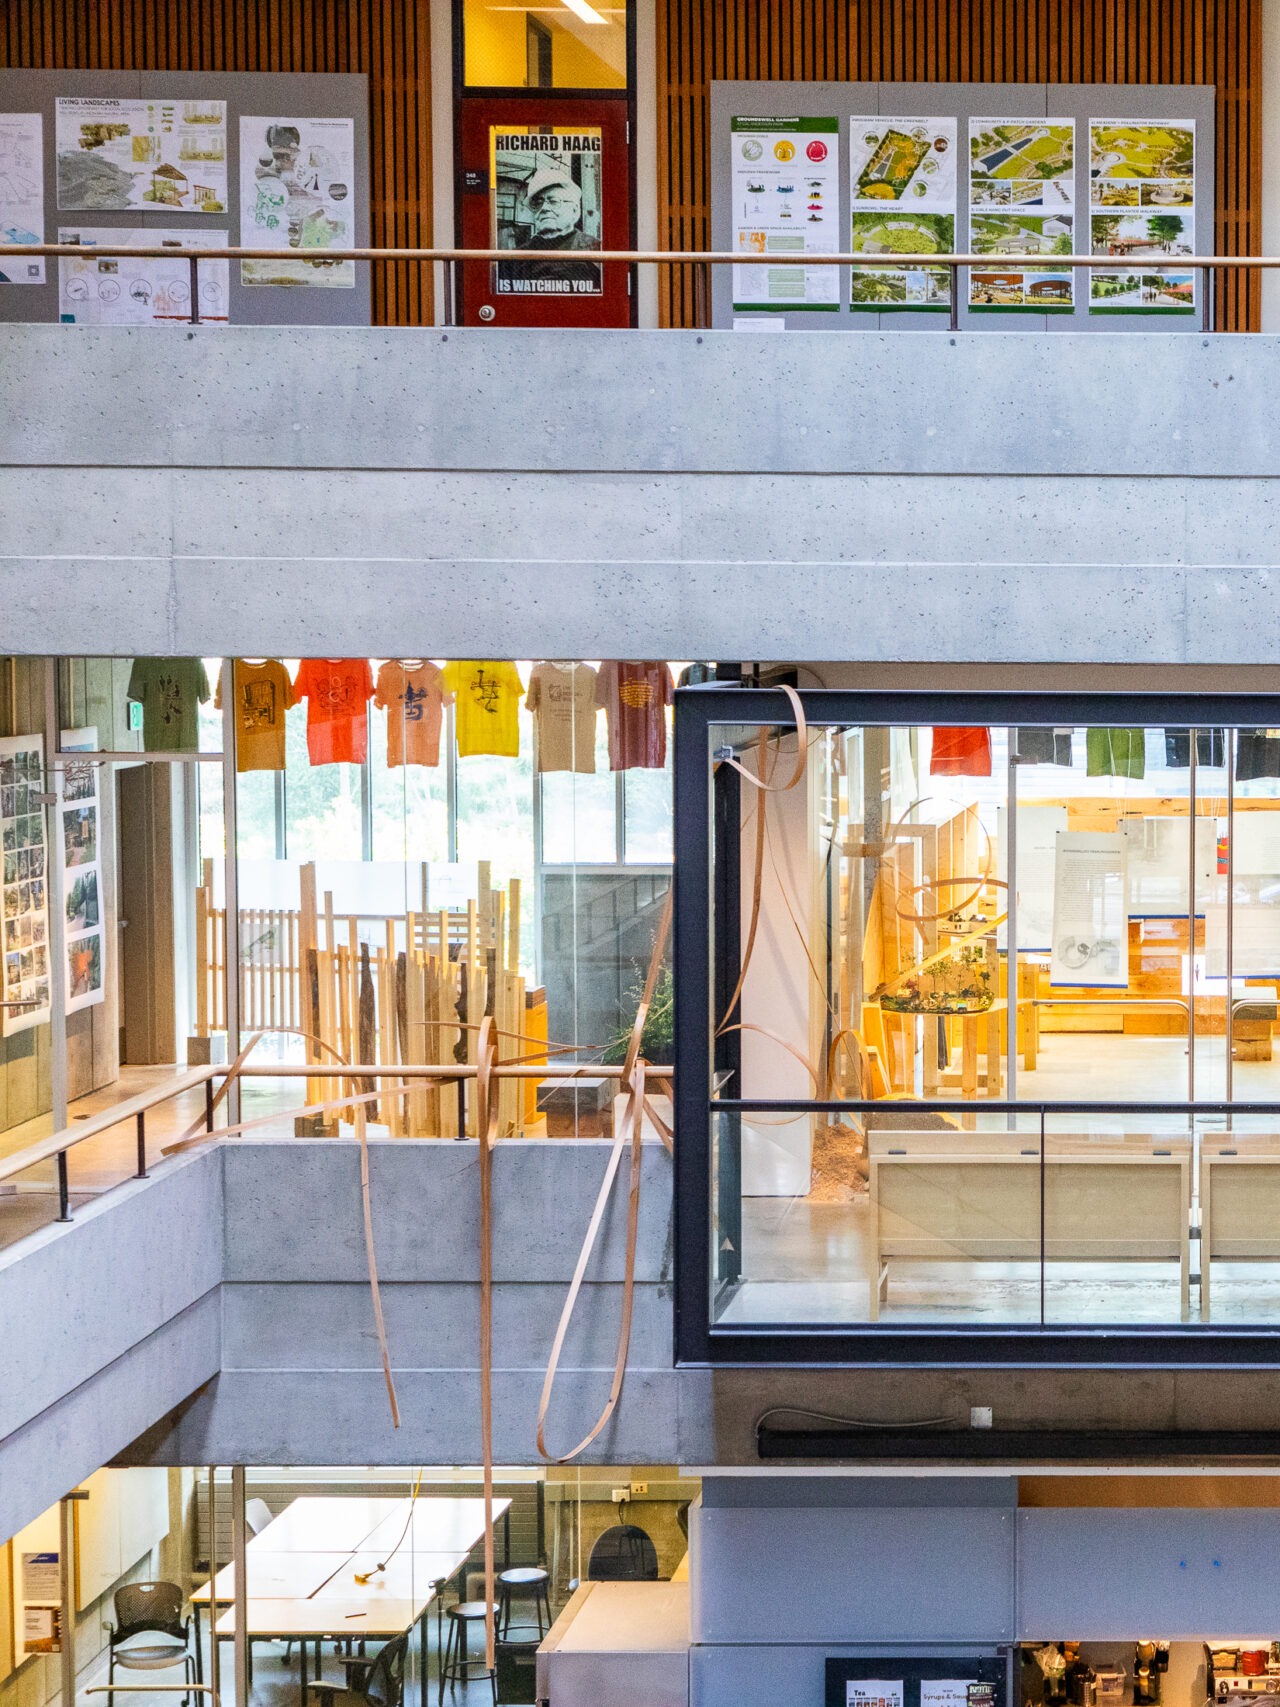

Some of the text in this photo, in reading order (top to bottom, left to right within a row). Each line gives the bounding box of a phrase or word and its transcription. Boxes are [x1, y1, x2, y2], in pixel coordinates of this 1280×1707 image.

[496, 135, 601, 151] RICHARD HAAG
[500, 279, 601, 292] IS WATCHING YOU...
